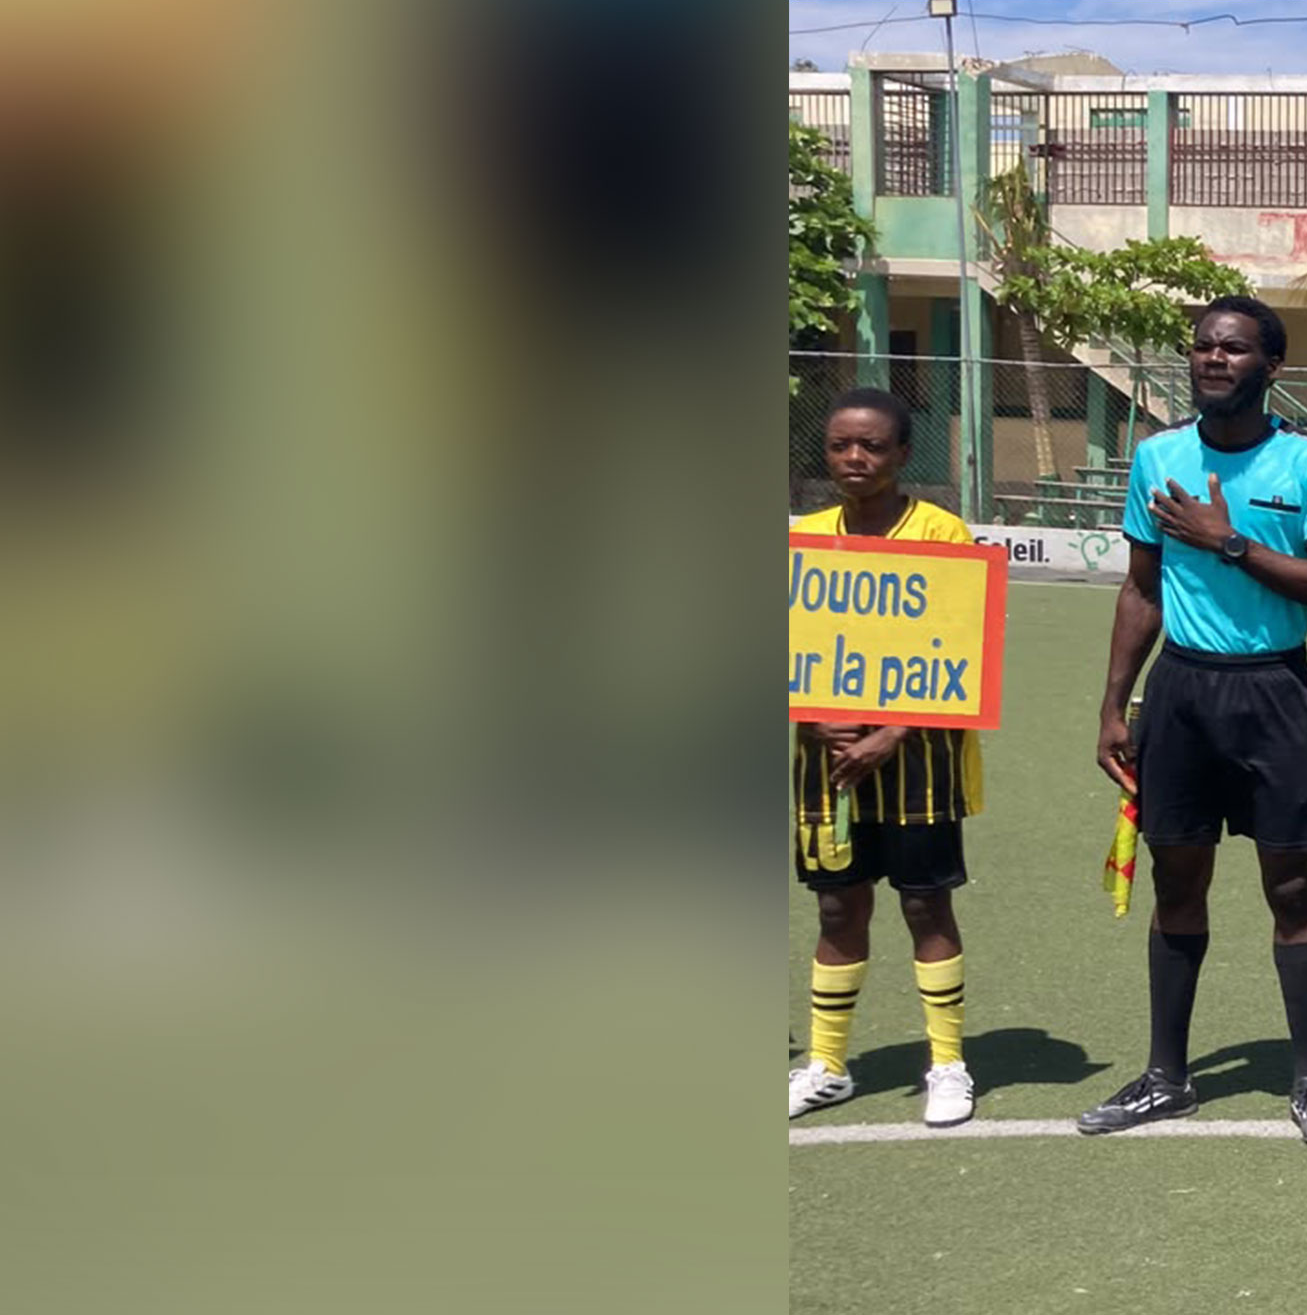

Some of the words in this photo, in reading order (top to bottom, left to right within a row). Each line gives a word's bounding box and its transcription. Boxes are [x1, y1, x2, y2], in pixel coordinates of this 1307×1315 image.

[974, 536, 1050, 564] leil.
[790, 552, 927, 618] Jouons
[833, 634, 867, 697] la
[878, 637, 968, 707] paix
